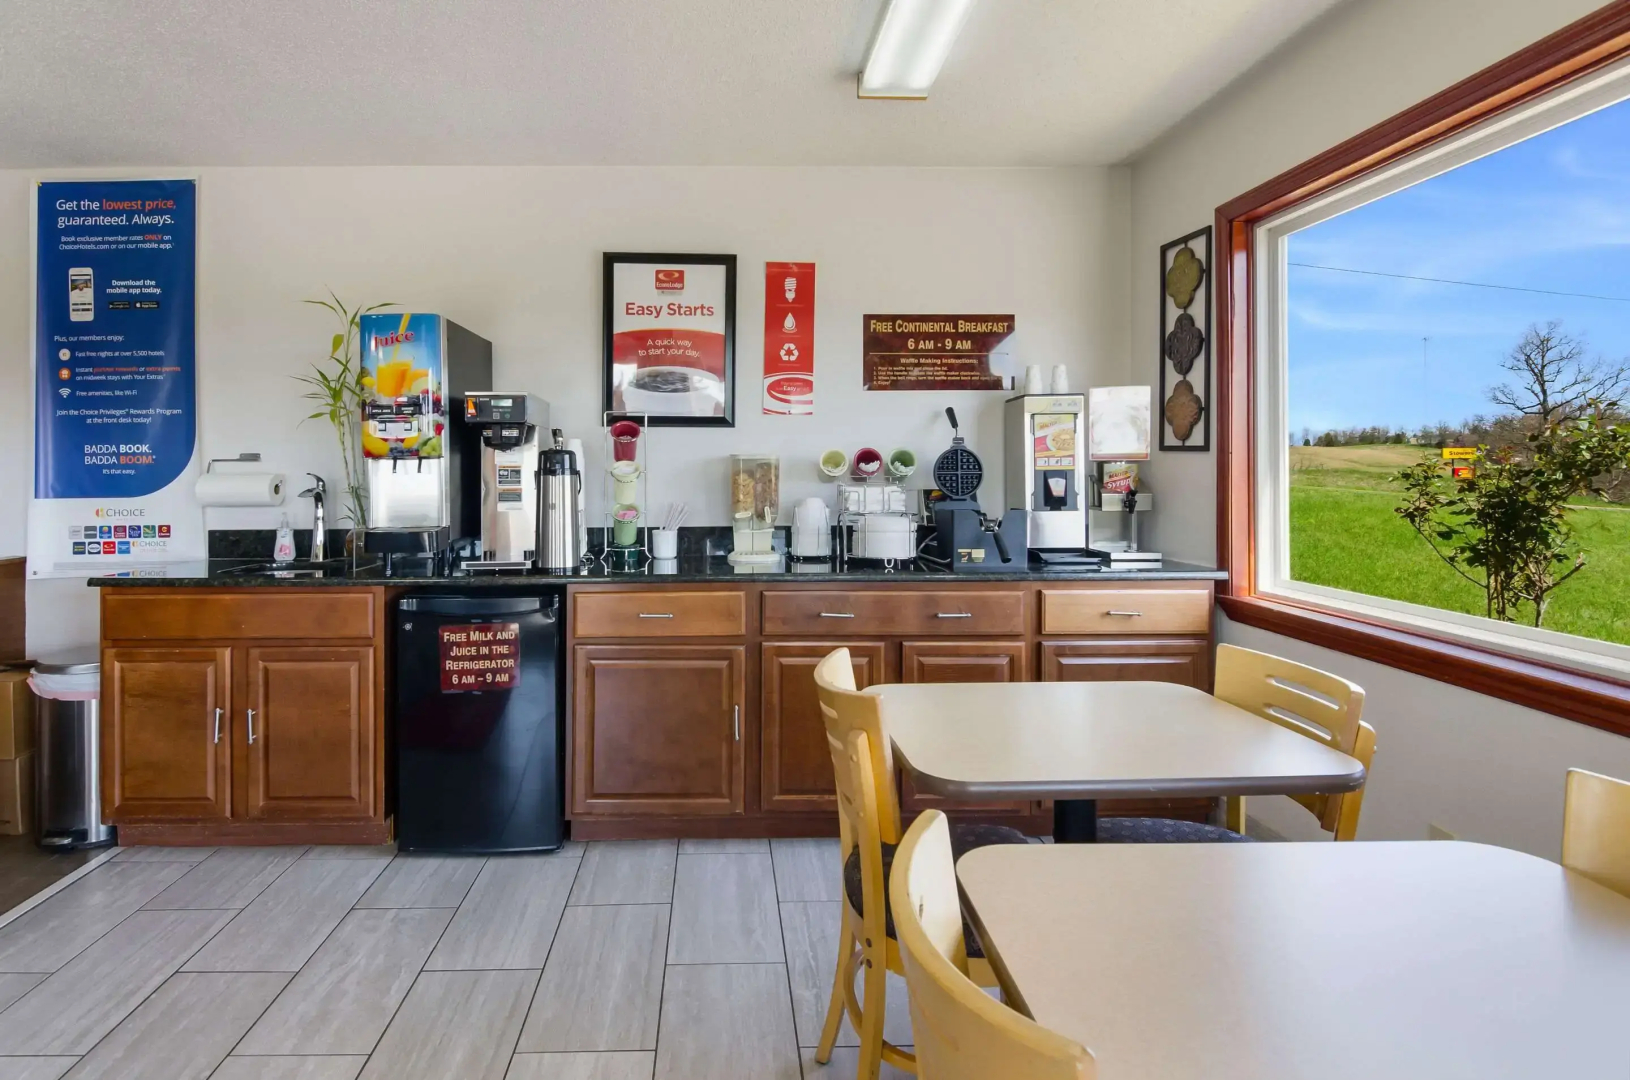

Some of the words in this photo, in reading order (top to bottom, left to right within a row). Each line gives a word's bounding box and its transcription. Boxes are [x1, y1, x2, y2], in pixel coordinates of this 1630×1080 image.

[56, 200, 77, 210] Get
[80, 199, 100, 210] the
[102, 199, 142, 210] lowest
[145, 199, 176, 211] price,
[58, 214, 128, 228] guaranteed.
[132, 214, 174, 226] Always.
[626, 302, 662, 318] Easy
[667, 303, 714, 316] Starts
[870, 320, 892, 332] FREE
[895, 319, 955, 333] CONTINENTAL
[958, 320, 1009, 333] BREAKFAST
[374, 331, 415, 348] Juice
[655, 338, 675, 347] quick
[908, 338, 914, 349] 6
[918, 341, 934, 349] AM
[945, 338, 952, 350] 9
[955, 341, 972, 349] AM
[686, 348, 700, 357] day.
[84, 445, 117, 453] BADDA
[119, 444, 152, 453] BOOK.
[84, 456, 117, 464] BADDA
[106, 508, 145, 517] CHOICE
[444, 632, 467, 642] FREE
[470, 631, 493, 641] MILK
[496, 631, 515, 640] AND
[450, 646, 477, 656] JUICE
[480, 646, 488, 654] IN
[491, 645, 509, 654] THE
[446, 659, 514, 670] REFRIGERATOR
[452, 674, 459, 684] 6
[461, 675, 475, 684] AM
[486, 673, 492, 682] 9
[495, 674, 509, 682] AM
